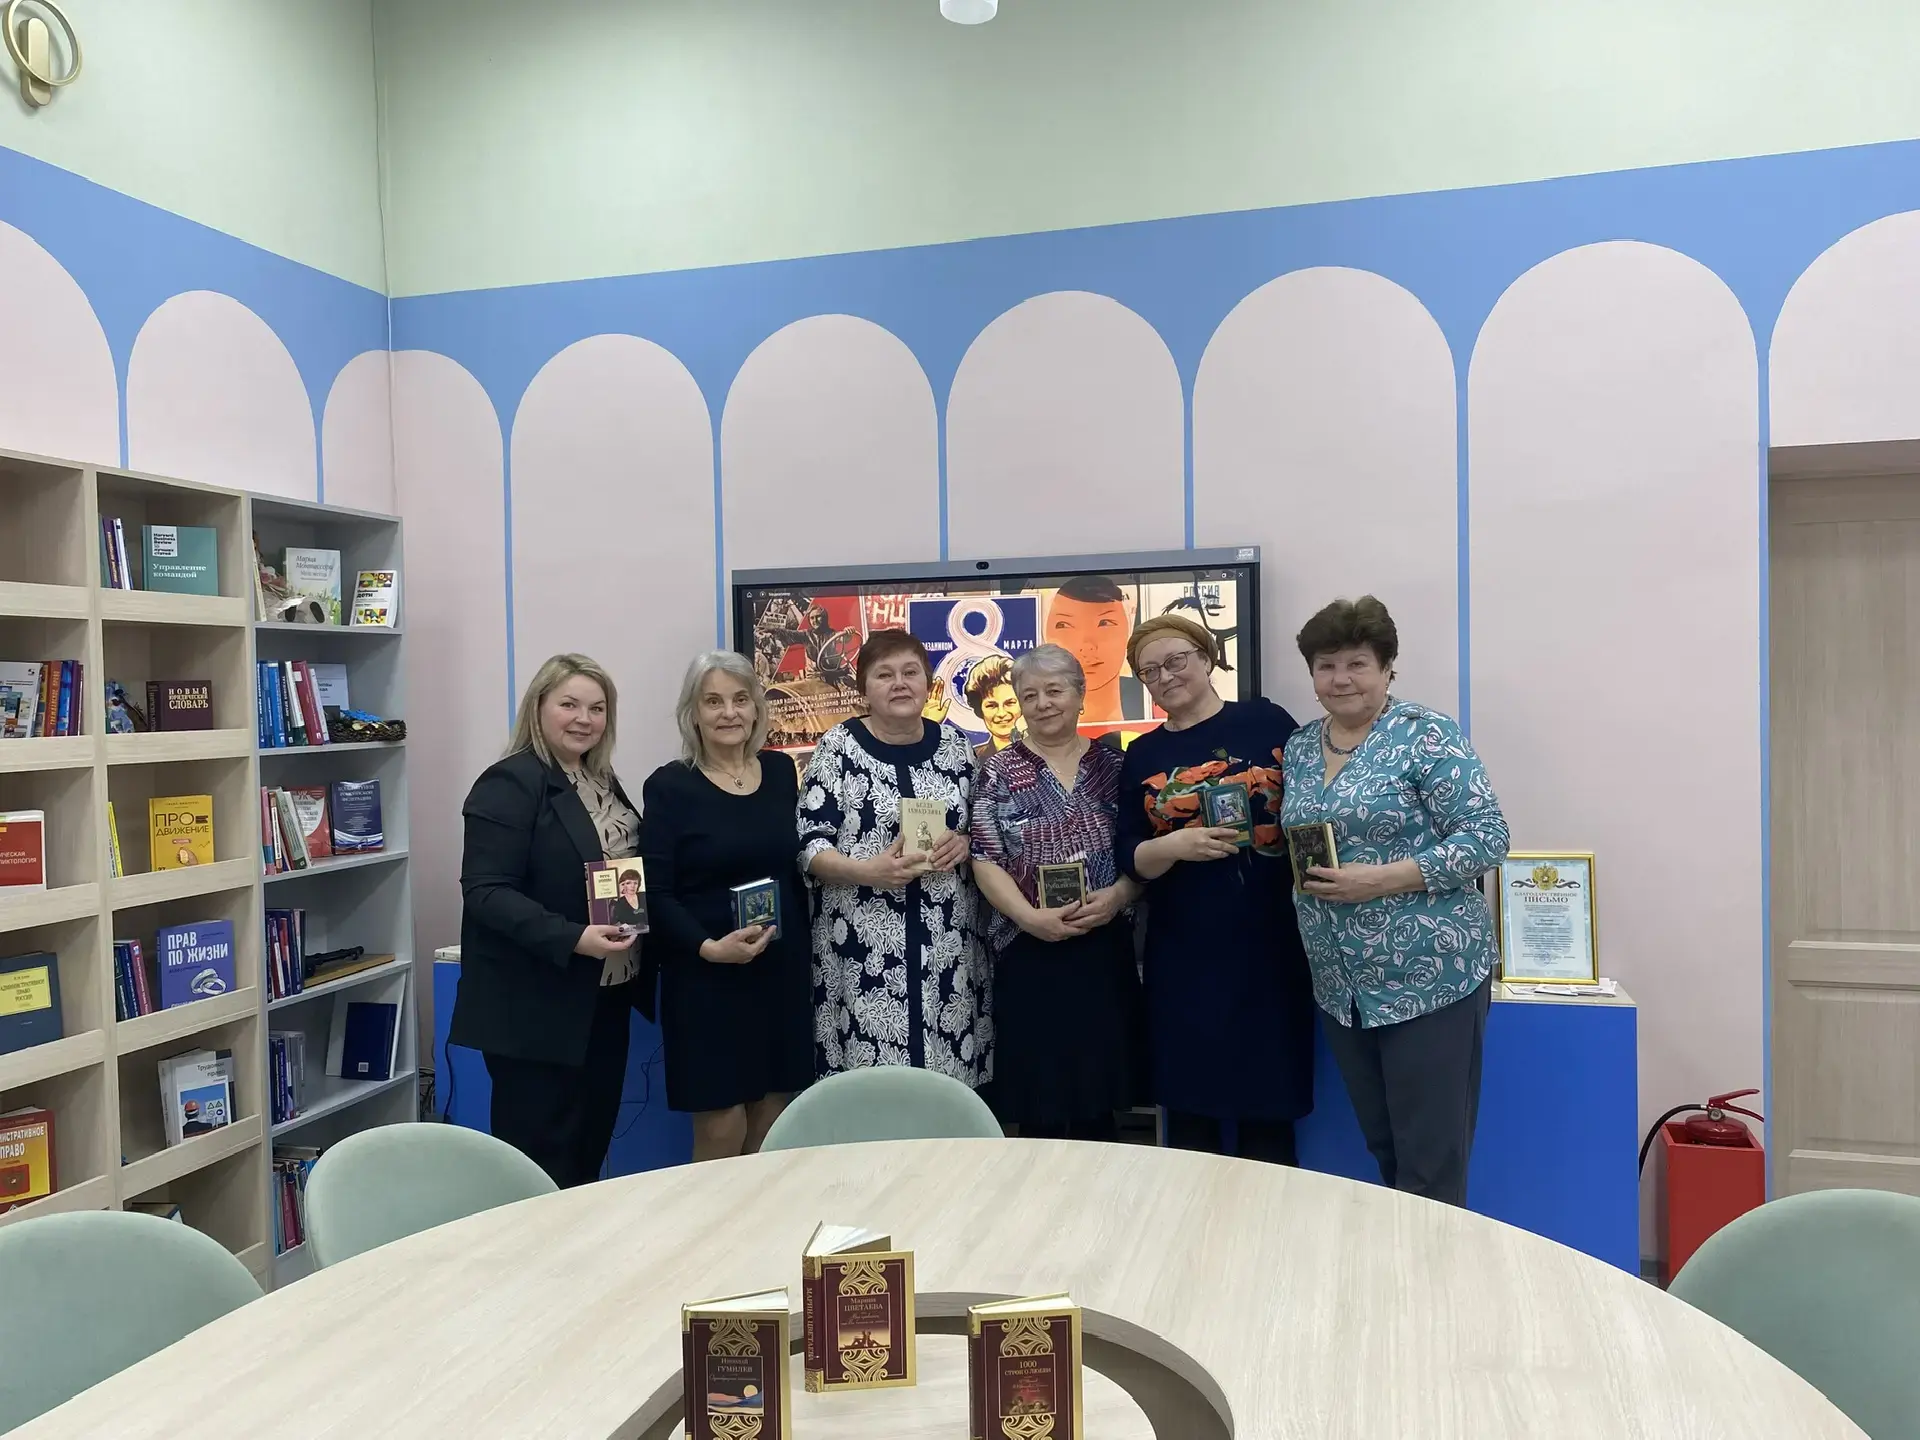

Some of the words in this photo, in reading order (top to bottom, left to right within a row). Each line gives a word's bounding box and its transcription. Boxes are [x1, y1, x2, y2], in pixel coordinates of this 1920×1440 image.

[296, 556, 317, 564] Мария
[152, 563, 207, 571] Управление
[1184, 585, 1220, 597] РОСИЯ
[1003, 639, 1034, 650] МАРТА
[168, 686, 208, 696] НОВЫЙ
[169, 699, 209, 709] СЛОВАРЬ
[155, 812, 195, 827] ПРО
[156, 825, 209, 837] ДВИЖЕНИЕ
[167, 931, 197, 950] ПРАВ
[168, 949, 183, 967] ПО
[187, 943, 229, 964] ЖИЗНИ
[207, 1069, 226, 1077] право
[0, 1143, 25, 1159] ПРАВО
[844, 1303, 884, 1312] ЦВЕТАЕВА
[721, 1357, 749, 1365] Николай
[1019, 1360, 1037, 1368] 1000
[717, 1365, 753, 1373] ГУМИЛЕВ
